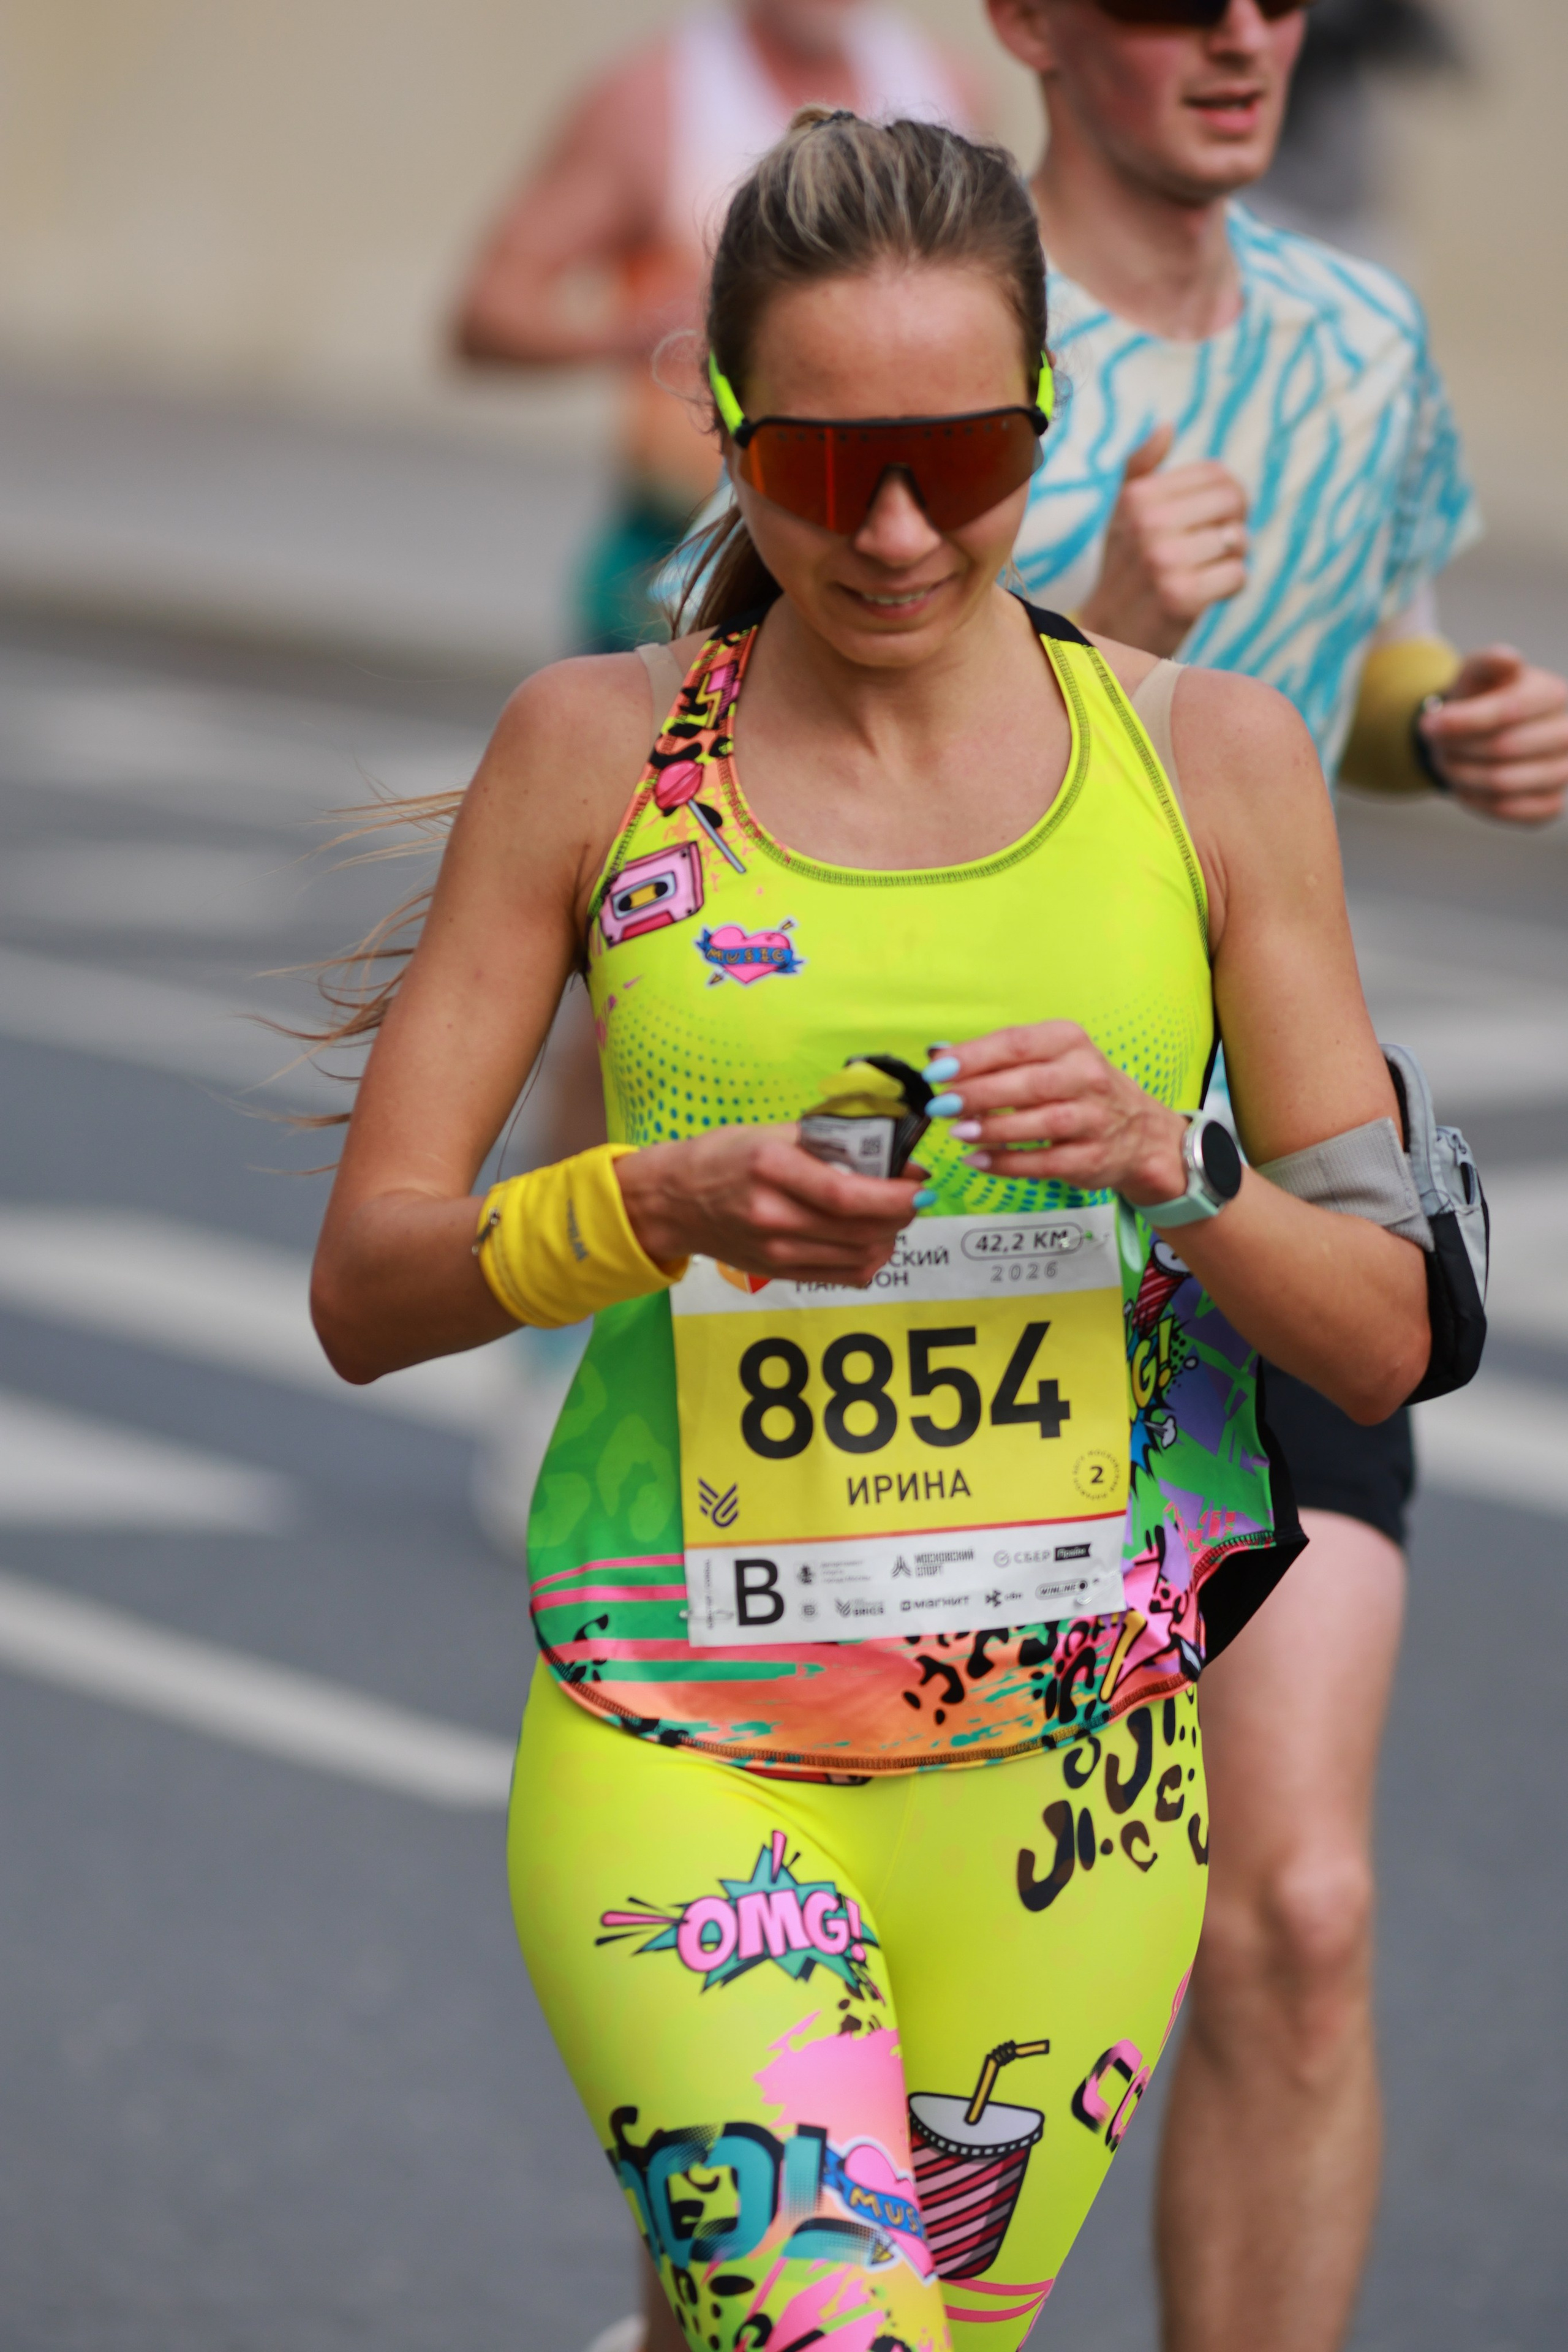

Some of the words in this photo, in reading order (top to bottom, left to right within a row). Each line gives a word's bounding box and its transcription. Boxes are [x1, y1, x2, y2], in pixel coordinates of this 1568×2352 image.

[707, 948, 785, 963] MUSIC
[976, 1232, 1023, 1253] 42,2
[739, 1320, 1071, 1460] 8854
[847, 1468, 972, 1506] ИРИНА
[1090, 1465, 1104, 1484] 2
[676, 1888, 867, 1973] OMG!
[849, 2185, 919, 2233] MUS
